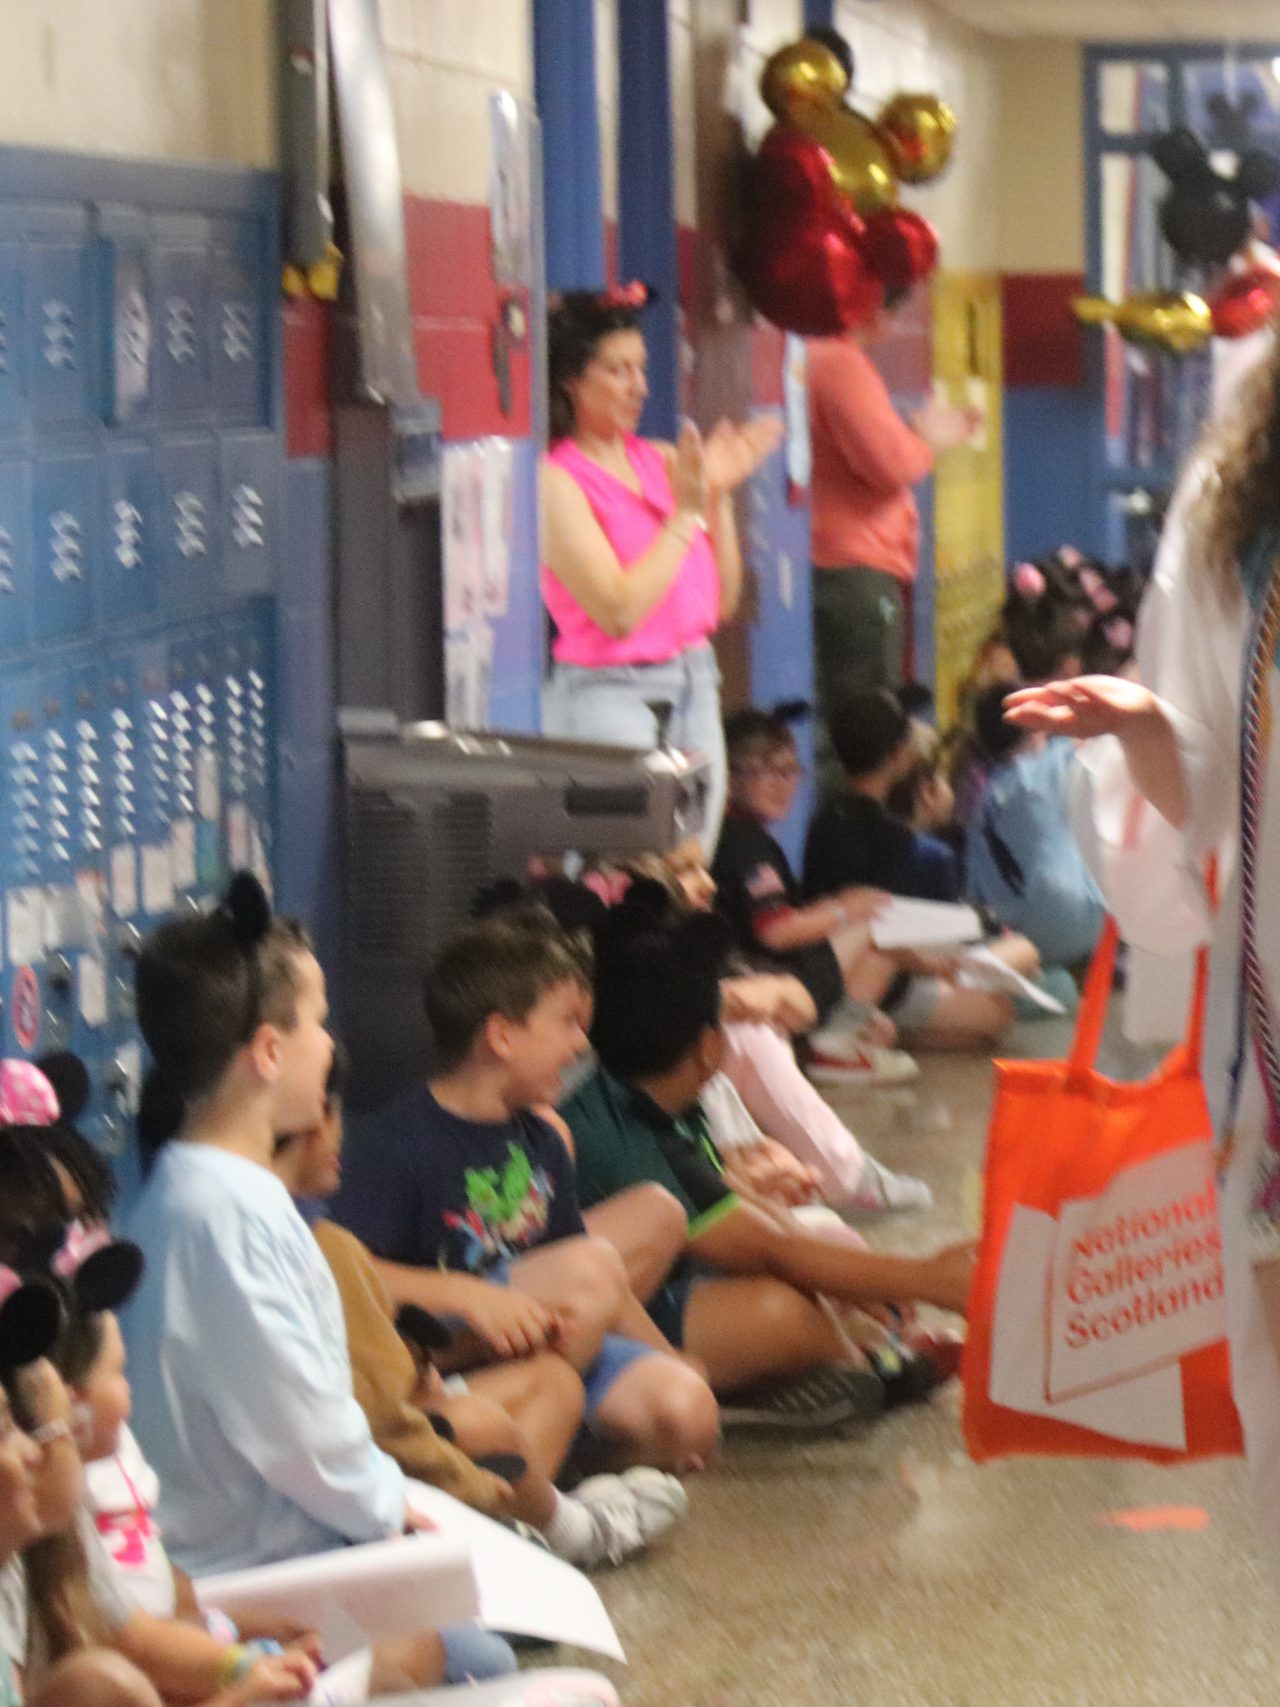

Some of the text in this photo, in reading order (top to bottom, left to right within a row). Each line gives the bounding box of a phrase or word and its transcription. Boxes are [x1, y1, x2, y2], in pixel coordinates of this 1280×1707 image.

[1073, 1177, 1216, 1257] National
[1065, 1262, 1225, 1349] Scotland
[1067, 1229, 1222, 1303] Galleries
